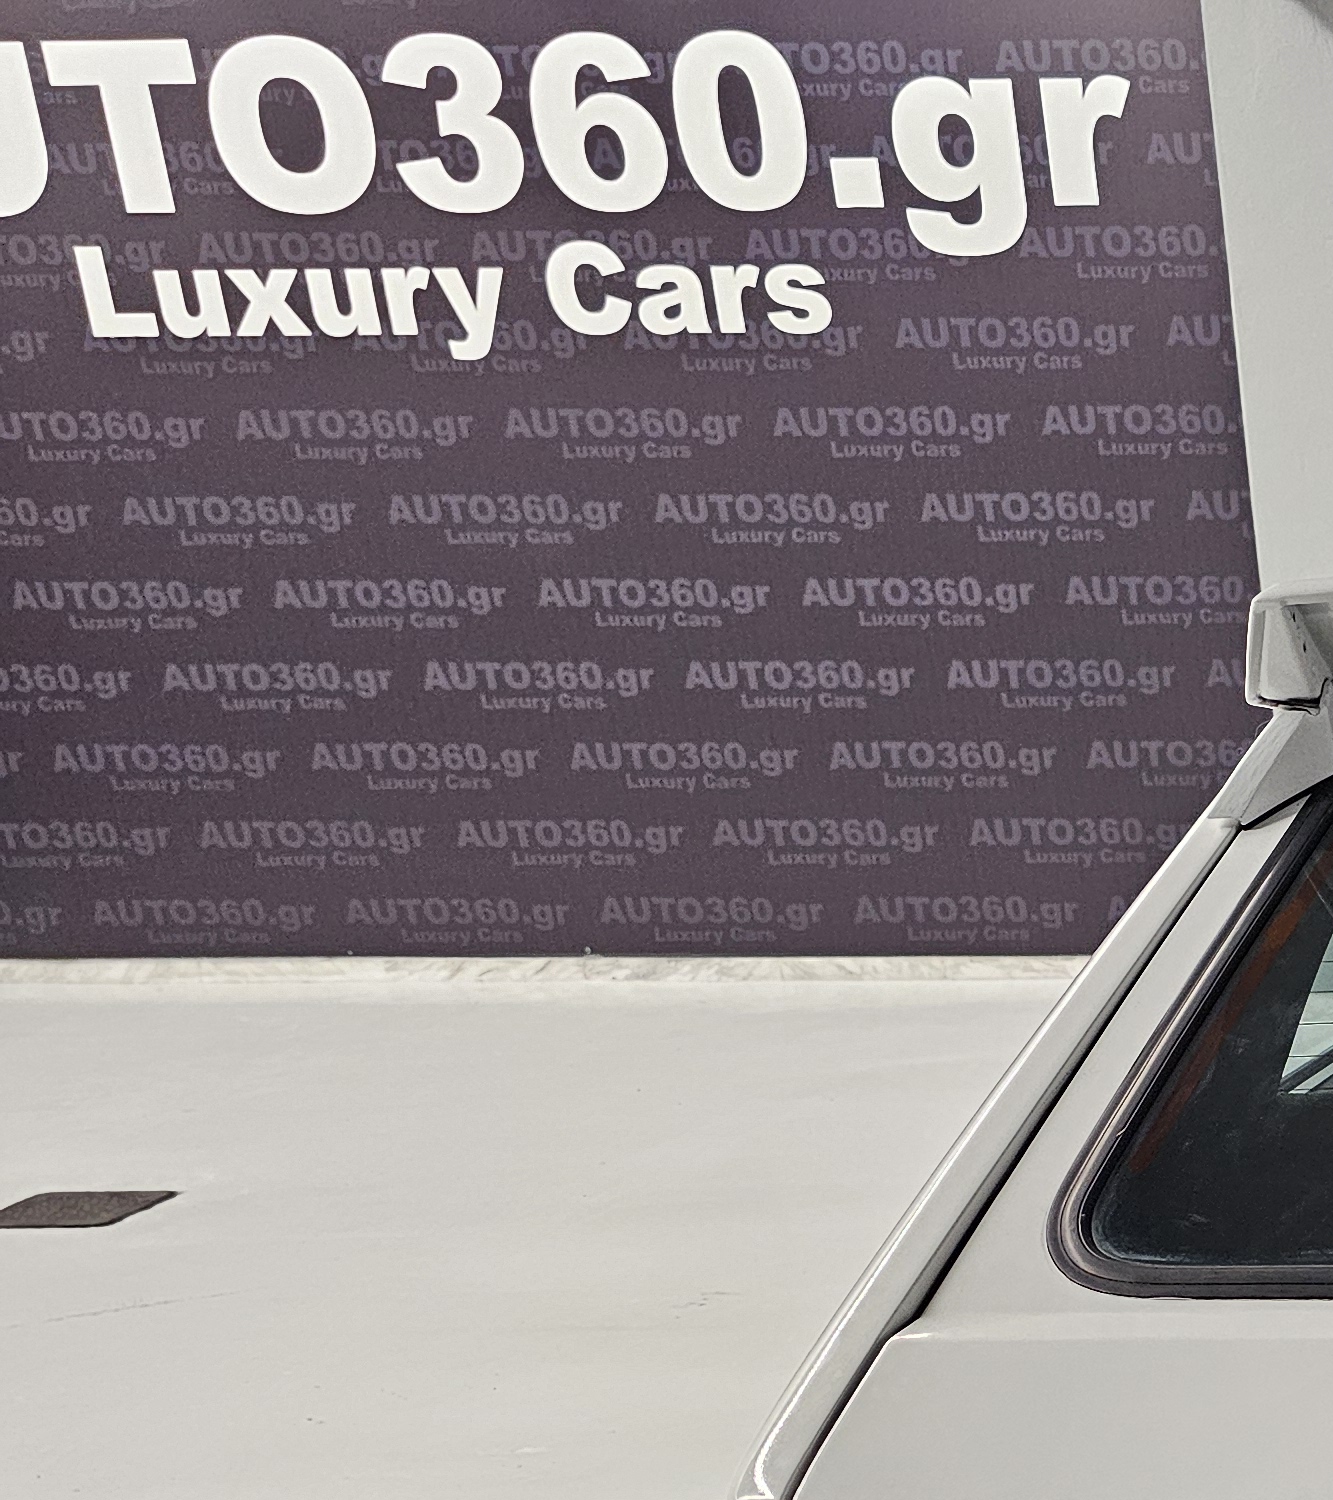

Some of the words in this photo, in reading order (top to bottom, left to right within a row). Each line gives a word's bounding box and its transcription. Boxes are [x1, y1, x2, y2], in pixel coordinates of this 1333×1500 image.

[996, 38, 1199, 73] AUTO360.
[198, 231, 439, 271] AUTO360.gr
[1018, 225, 1222, 260] AUTO360.
[884, 259, 936, 281] Cars
[1076, 261, 1151, 284] Luxury
[1158, 258, 1208, 279] Cars
[73, 240, 503, 360] Luxury
[546, 240, 833, 336] Cars
[895, 316, 1134, 355] AUTO360.gr
[221, 355, 274, 375] Cars
[763, 352, 813, 372] Cars
[237, 409, 473, 447] AUTO360.gr
[505, 407, 741, 445] AUTO360.gr
[774, 405, 1011, 444] AUTO360.gr
[123, 495, 356, 533] AUTO360.gr
[389, 493, 622, 531] AUTO360.gr
[655, 493, 889, 530] AUTO360.gr
[921, 491, 1155, 529] AUTO360.gr
[14, 580, 243, 617] AUTO360.gr
[274, 579, 506, 615] AUTO360.gr
[538, 577, 770, 614] AUTO360.gr
[803, 577, 1034, 613] AUTO360.gr
[163, 662, 392, 698] AUTO360.gr
[424, 660, 654, 697] AUTO360.gr
[685, 660, 915, 696] AUTO360.gr
[947, 659, 1175, 695] AUTO360.gr
[54, 743, 280, 779] AUTO360.gr
[311, 741, 539, 778] AUTO360.gr
[571, 741, 798, 777] AUTO360.gr
[830, 740, 1057, 776] AUTO360.gr
[200, 819, 425, 854] AUTO360.gr
[457, 819, 684, 854] AUTO360.gr
[713, 818, 939, 853] AUTO360.gr
[93, 898, 315, 933] AUTO360.gr
[346, 897, 570, 931] AUTO360.gr
[600, 896, 823, 931] AUTO360.gr
[854, 895, 1079, 929] AUTO360.gr
